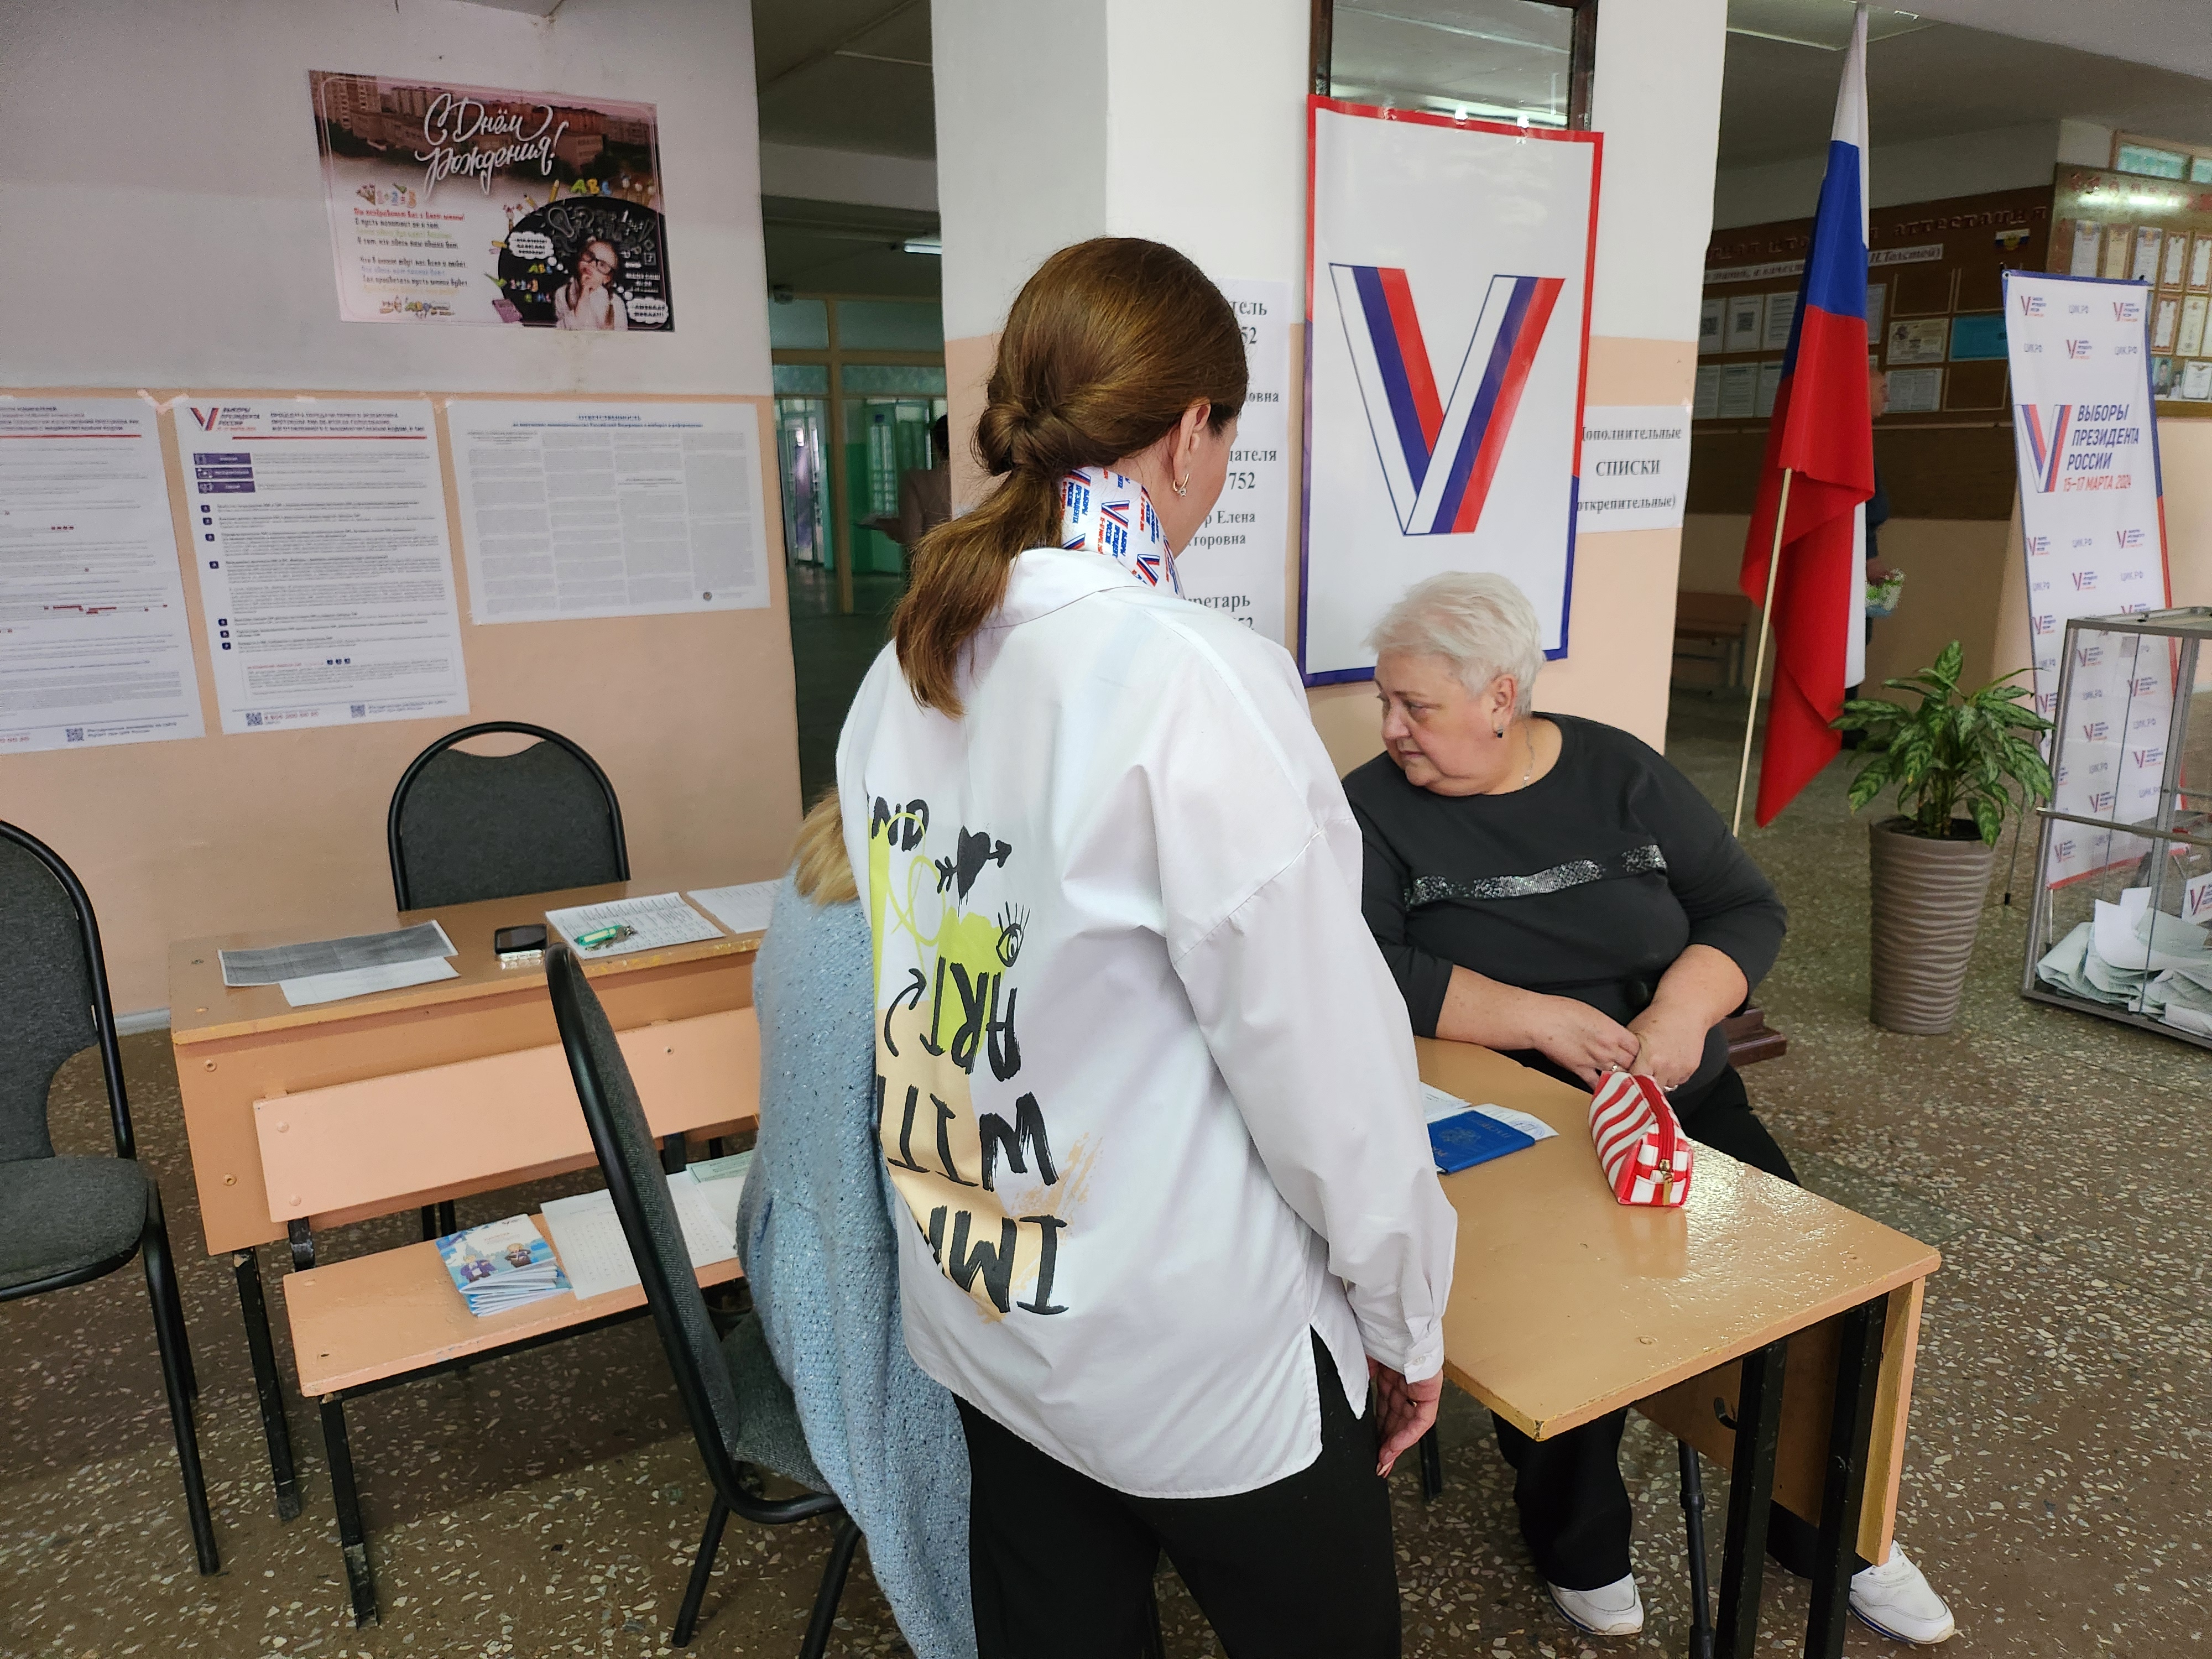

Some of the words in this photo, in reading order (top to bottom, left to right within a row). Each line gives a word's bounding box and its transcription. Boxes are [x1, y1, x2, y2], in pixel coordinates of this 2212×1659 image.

[1246, 392, 1279, 402] овна
[2077, 404, 2129, 422] ВЫБОРЫ
[2072, 428, 2140, 448] ПРЕЗИДЕНТА
[1596, 460, 1661, 476] СПИСКИ
[2067, 452, 2112, 471] РОССИИ
[1228, 472, 1256, 490] 752
[2085, 475, 2114, 491] МАРТА
[1217, 511, 1256, 524] Елена
[1189, 534, 1246, 550] торовна
